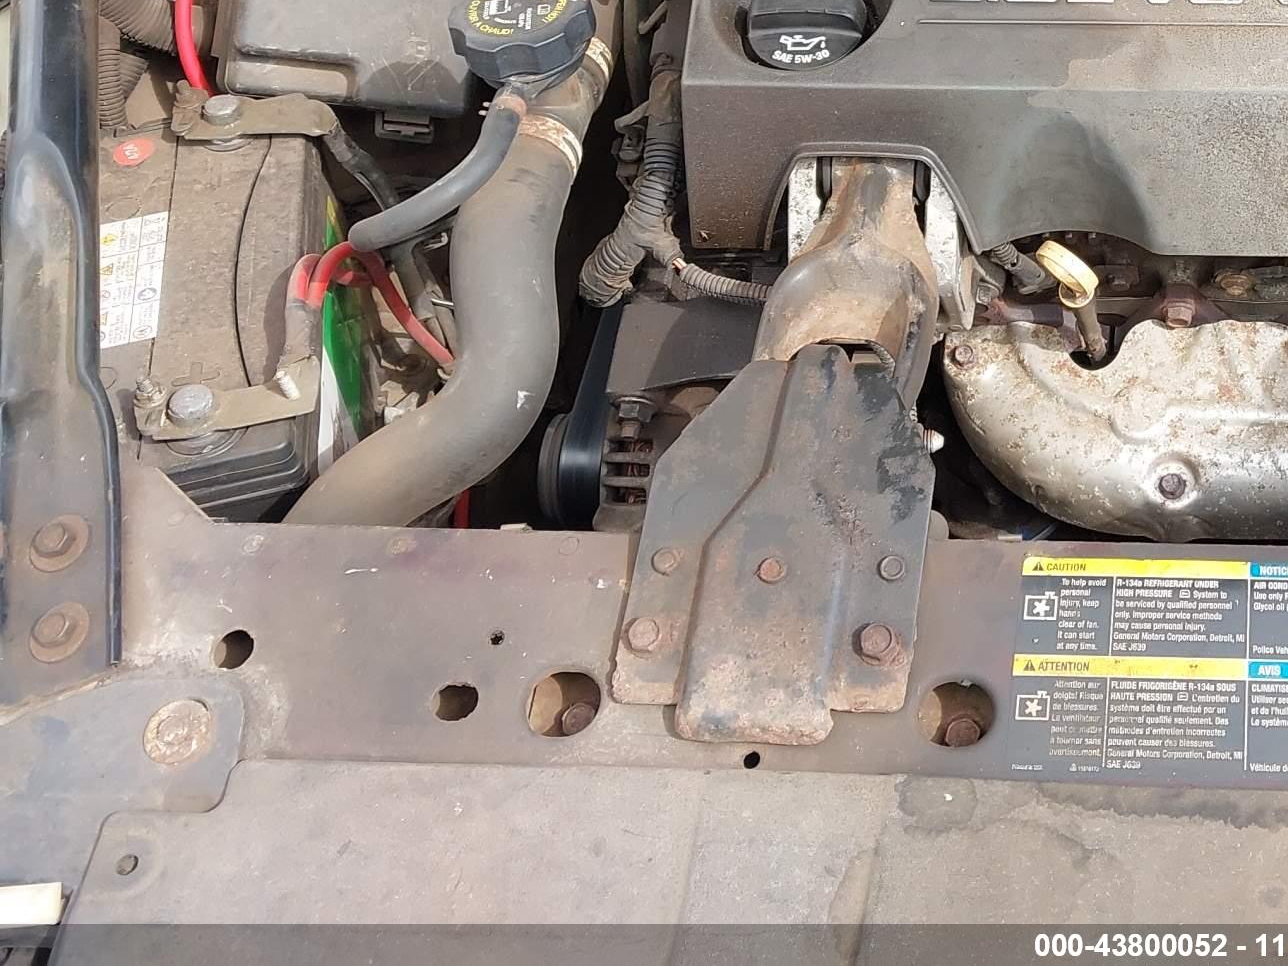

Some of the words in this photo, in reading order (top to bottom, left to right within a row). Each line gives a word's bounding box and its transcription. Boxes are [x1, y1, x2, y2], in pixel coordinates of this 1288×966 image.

[772, 50, 792, 62] SAE
[795, 50, 830, 63] 5W-30
[1047, 563, 1086, 571] CAUTION
[1144, 580, 1192, 588] REFRIGERANT
[1194, 580, 1218, 588] UNDER
[1061, 589, 1090, 597] personal
[1116, 589, 1134, 597] HIGH
[1194, 591, 1218, 599] System
[1269, 593, 1282, 601] only
[1083, 600, 1099, 608] keep
[1167, 602, 1196, 610] qualified
[1198, 602, 1232, 610] personnel
[1059, 620, 1075, 628] clear
[1078, 620, 1084, 628] of
[1153, 622, 1183, 630] personal
[1185, 623, 1205, 631] injury.
[1114, 632, 1139, 640] General
[1167, 633, 1208, 642] Corporation,
[1210, 634, 1234, 642] Detroit,
[1253, 646, 1274, 654] Police
[1039, 662, 1089, 671] ATTENTION
[1258, 666, 1280, 675] AVIS
[1112, 681, 1136, 689] FLUIDE
[1139, 681, 1187, 690] FRIGORIGÈNE
[1111, 692, 1134, 700] HAUTE
[1137, 693, 1172, 701] PRESSION
[1252, 696, 1276, 704] Utiliser
[1110, 704, 1139, 712] système
[1186, 728, 1225, 736] incorrectes
[1108, 738, 1136, 746] peuvent
[1136, 750, 1160, 758] Motors
[1162, 750, 1204, 759] Corporation,
[1207, 751, 1232, 760] Detroit,
[1106, 760, 1120, 768] SAE
